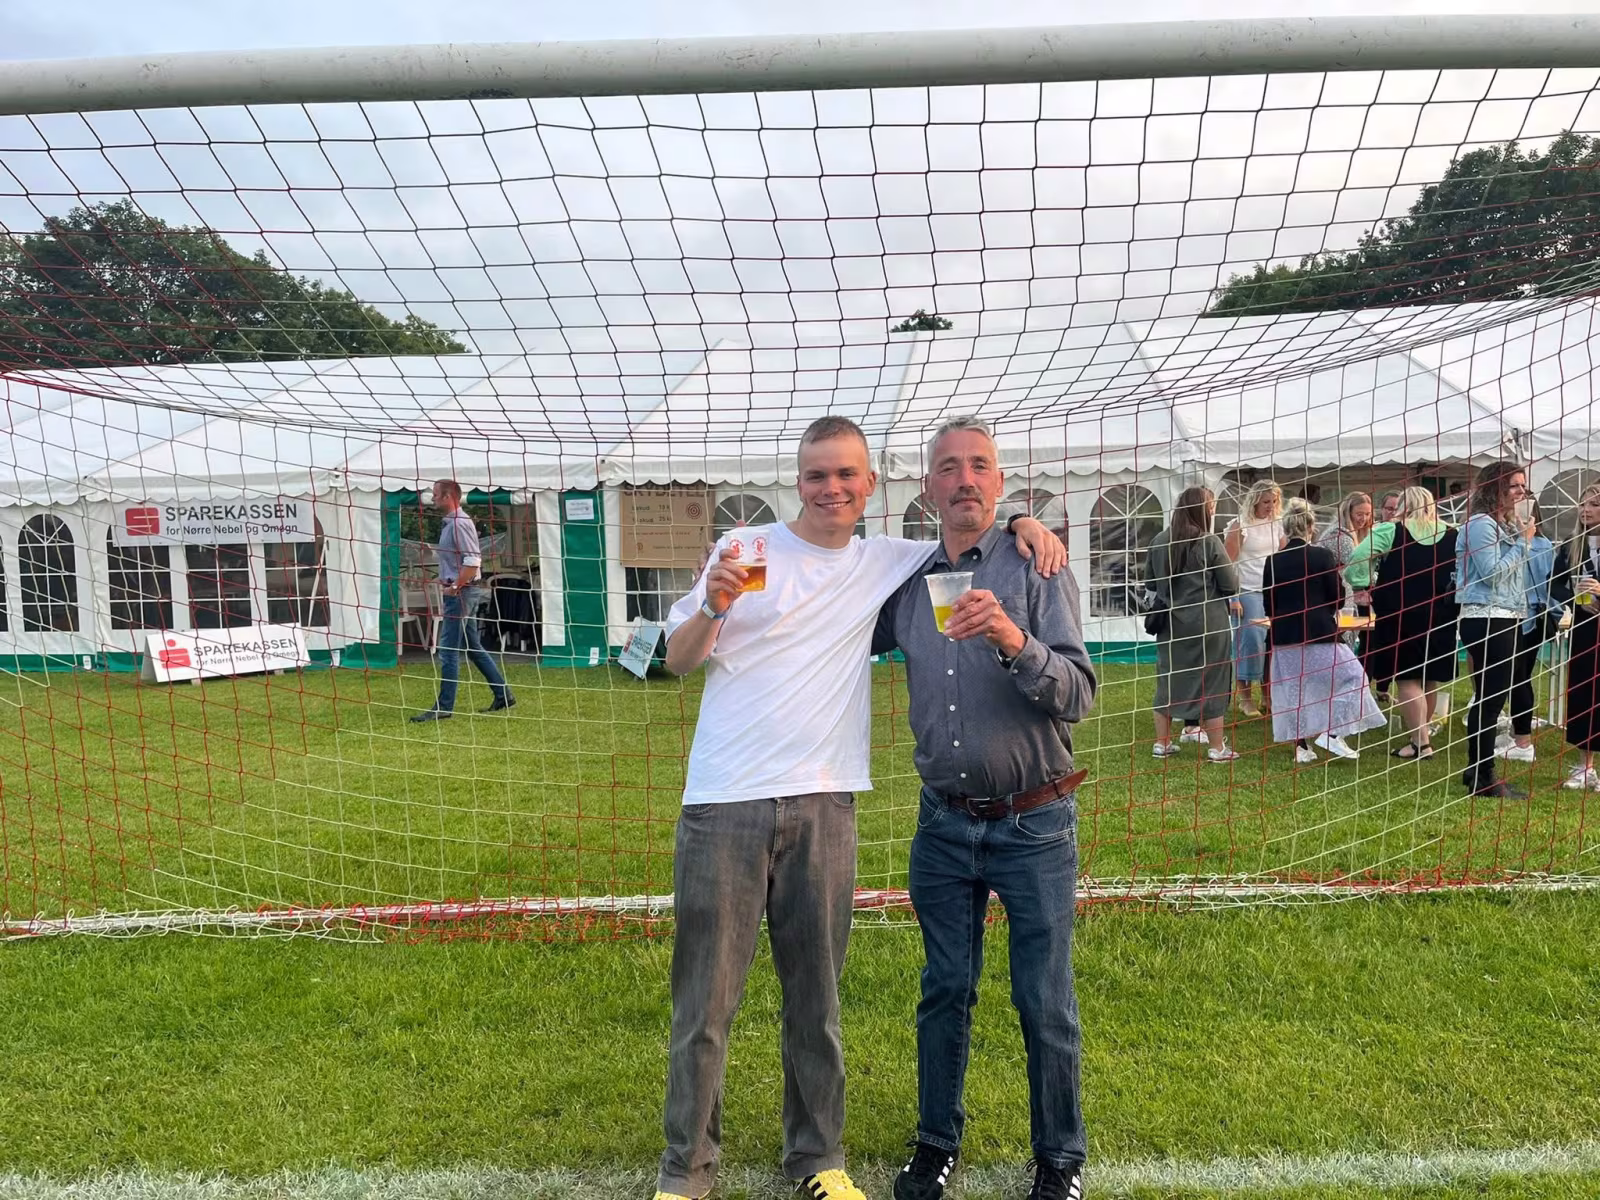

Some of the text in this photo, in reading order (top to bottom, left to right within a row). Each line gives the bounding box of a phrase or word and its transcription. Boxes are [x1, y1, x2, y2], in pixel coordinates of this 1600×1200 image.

[165, 503, 297, 522] SPAREKASSEN
[166, 523, 298, 536] for Nørre Nebel og Omegn
[193, 638, 298, 657] SPAREKASSEN
